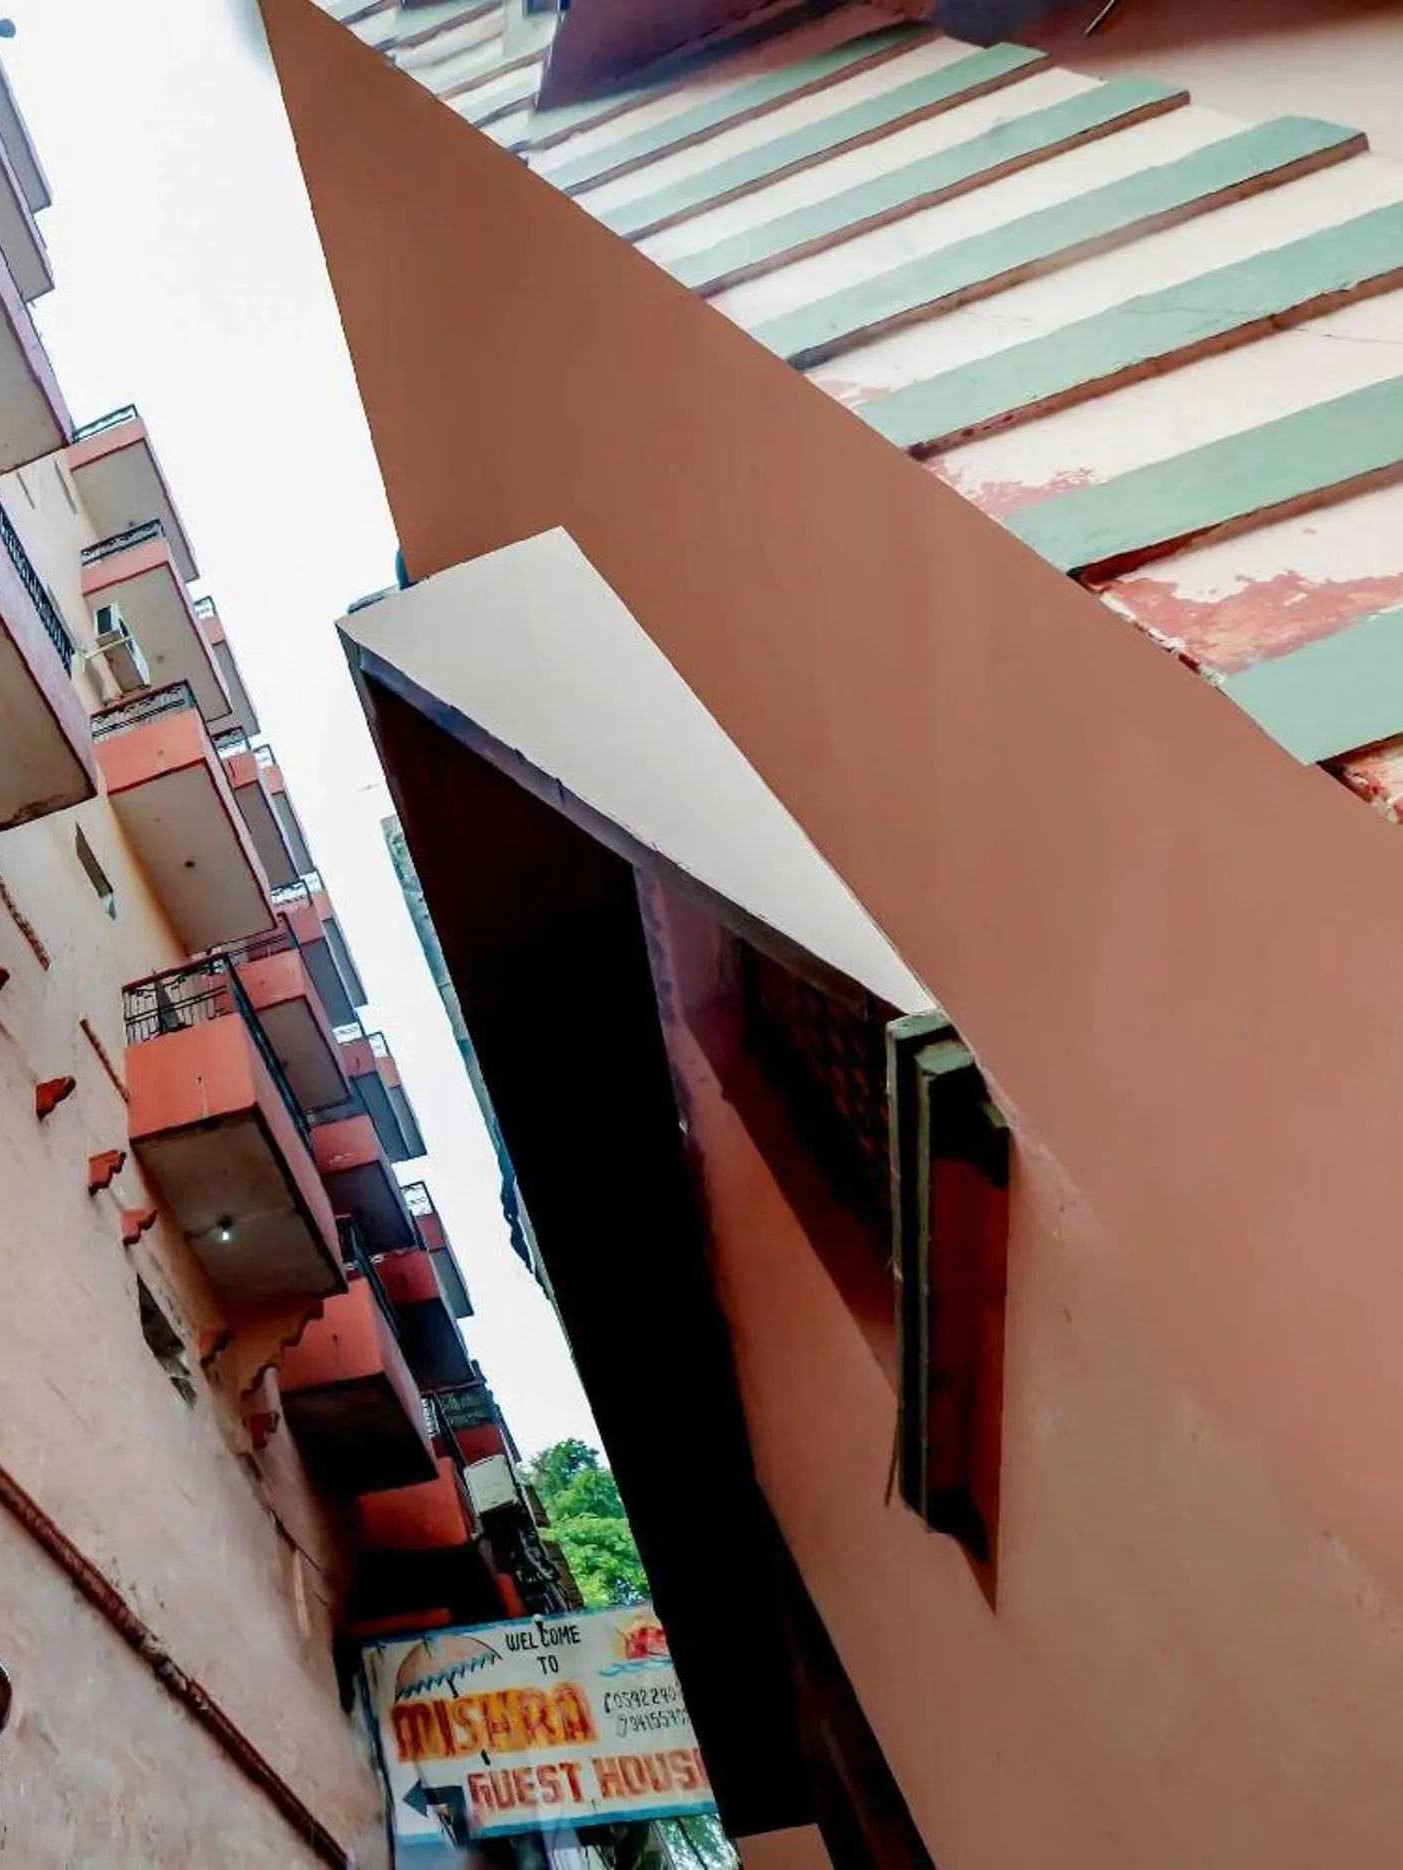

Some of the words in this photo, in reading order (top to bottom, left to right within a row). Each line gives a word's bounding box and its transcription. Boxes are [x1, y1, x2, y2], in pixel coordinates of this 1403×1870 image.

[505, 1624, 581, 1651] WELCOME
[537, 1655, 560, 1675] TO
[391, 1681, 599, 1762] MISHRA
[466, 1759, 584, 1810] GUEST
